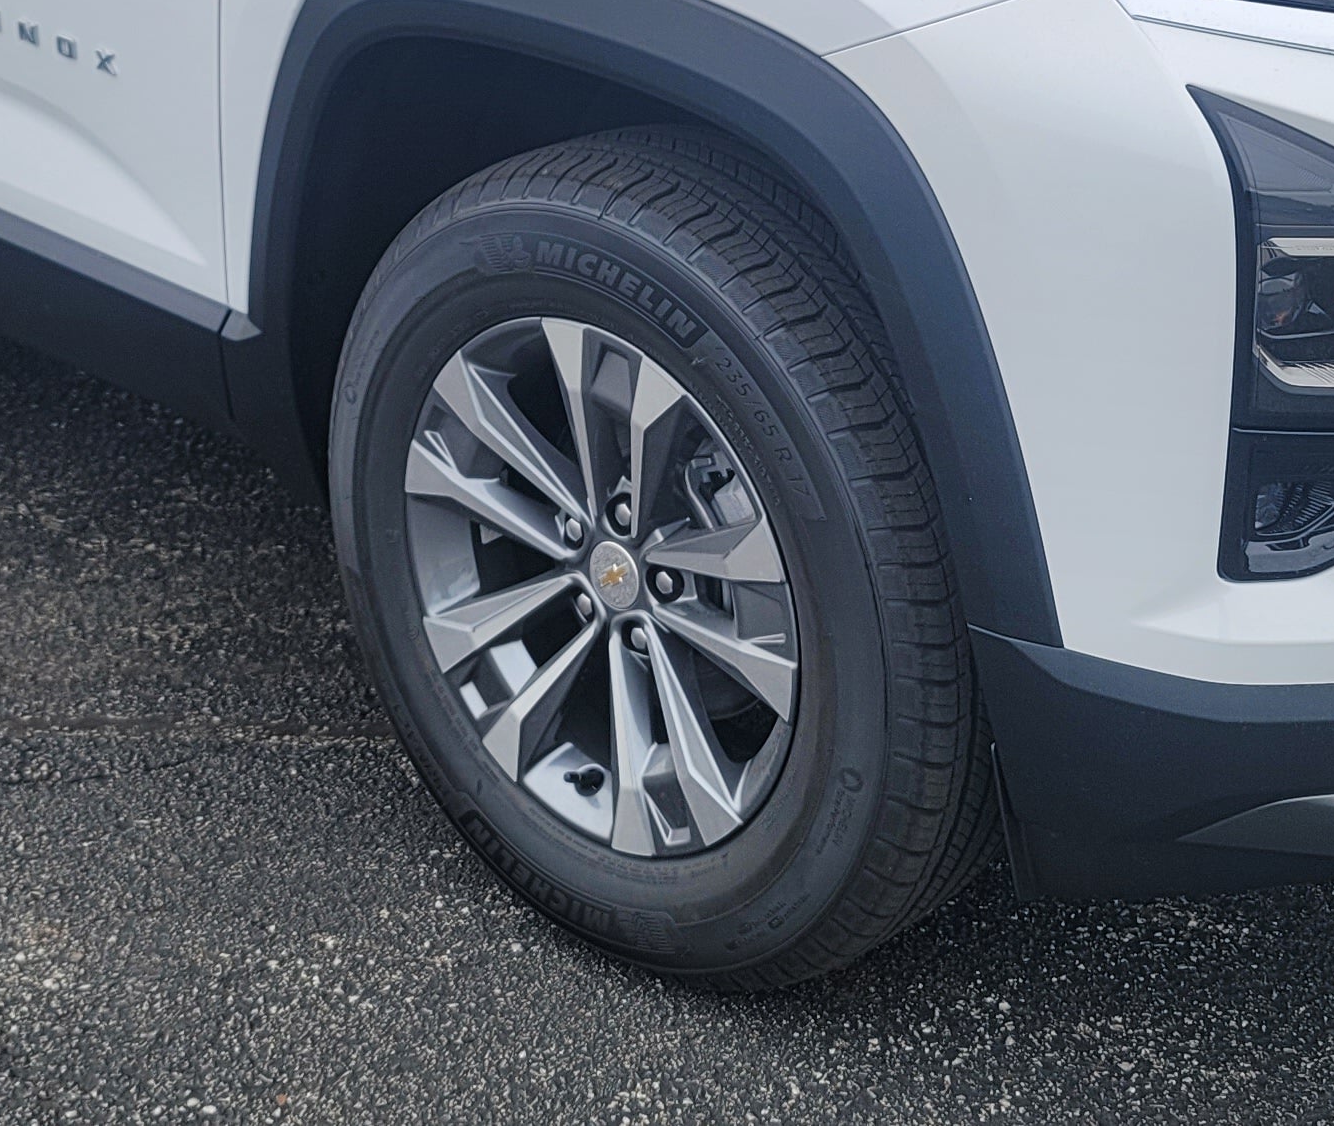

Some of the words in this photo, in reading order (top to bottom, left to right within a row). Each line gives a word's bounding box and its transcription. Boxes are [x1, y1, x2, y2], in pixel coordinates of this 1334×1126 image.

[536, 240, 698, 340] MICHELIN
[715, 357, 780, 437] 235/65
[774, 447, 793, 463] R
[786, 476, 812, 497] 17
[468, 816, 612, 929] MICHELIN
